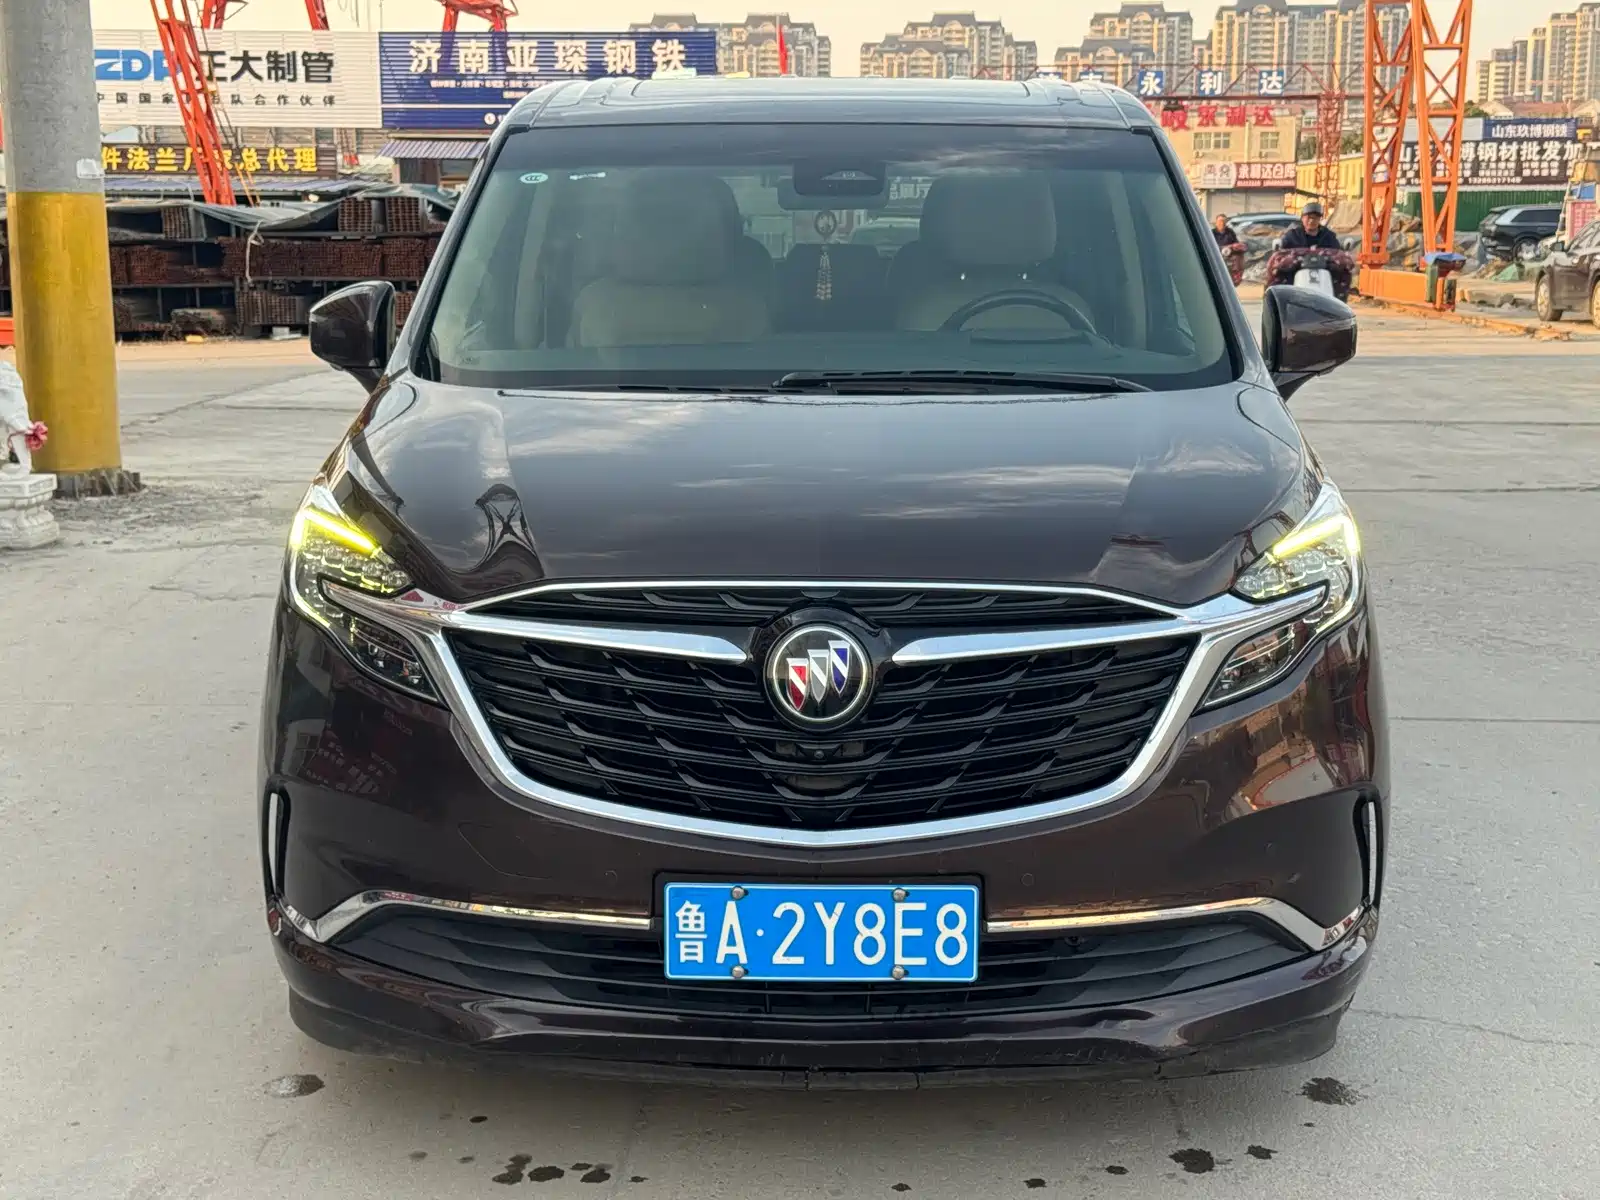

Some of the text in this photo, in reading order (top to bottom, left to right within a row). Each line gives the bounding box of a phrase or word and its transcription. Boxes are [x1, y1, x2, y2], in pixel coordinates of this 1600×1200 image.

[197, 50, 335, 83] 正大制管
[409, 39, 687, 75] 济南亚琛钢铁
[97, 92, 336, 107] 中国国家队合作伙伴
[674, 900, 968, 966] 鲁A·2Y8E8
